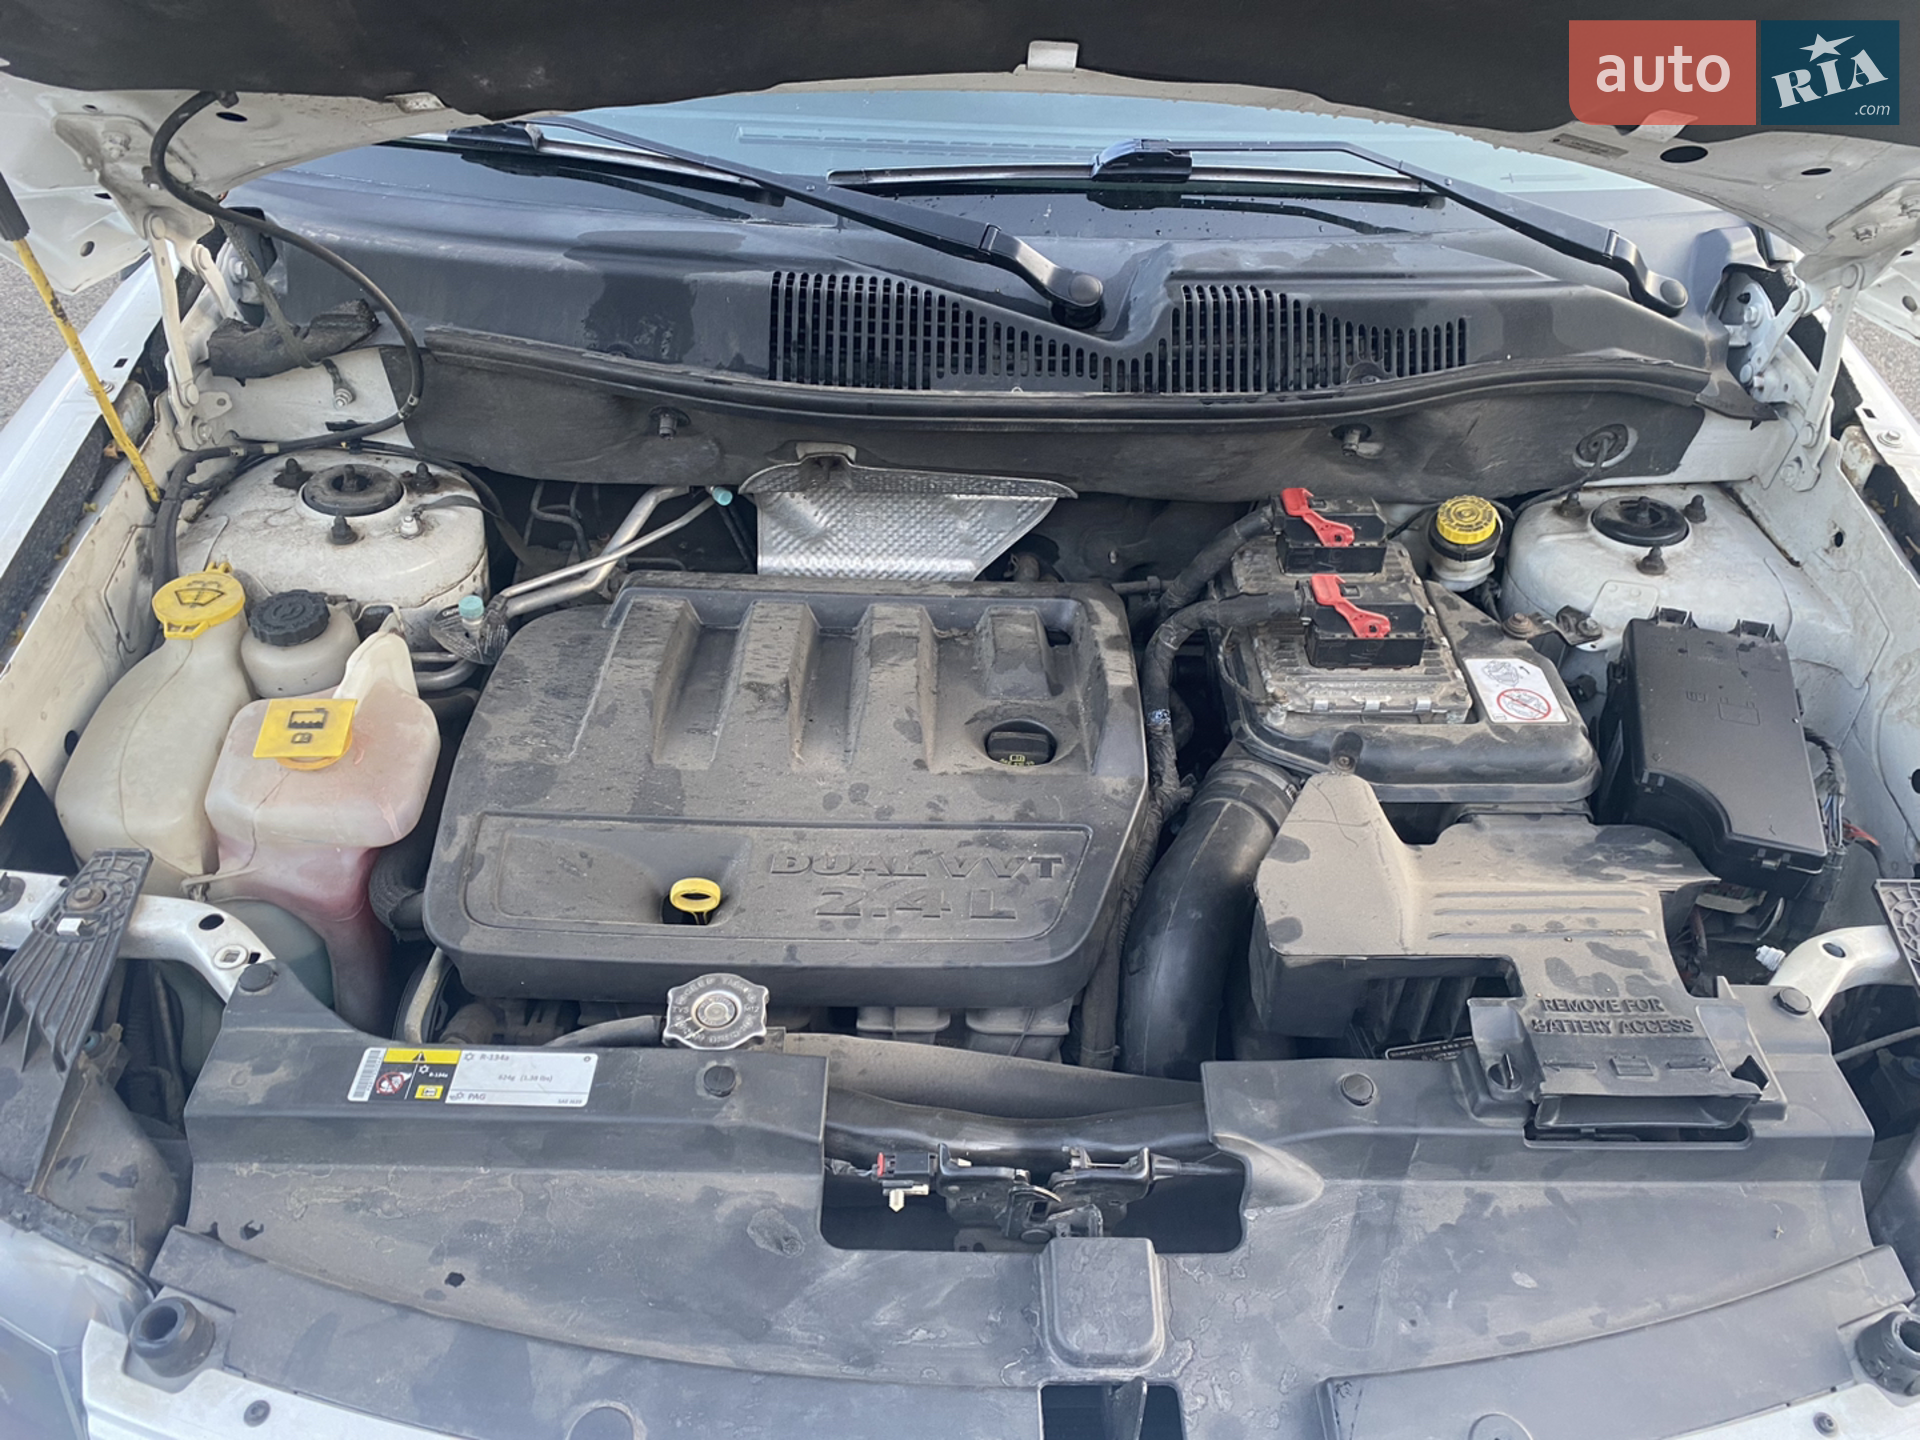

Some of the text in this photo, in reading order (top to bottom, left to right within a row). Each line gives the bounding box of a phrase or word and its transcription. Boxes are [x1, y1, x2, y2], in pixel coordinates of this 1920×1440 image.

[770, 854, 1063, 878] DUAL VVT
[1542, 999, 1666, 1014] REMOVE FOR
[1530, 1018, 1695, 1034] BATTERY ACCESS
[479, 1053, 510, 1062] R-134a
[467, 1092, 486, 1101] PAG
